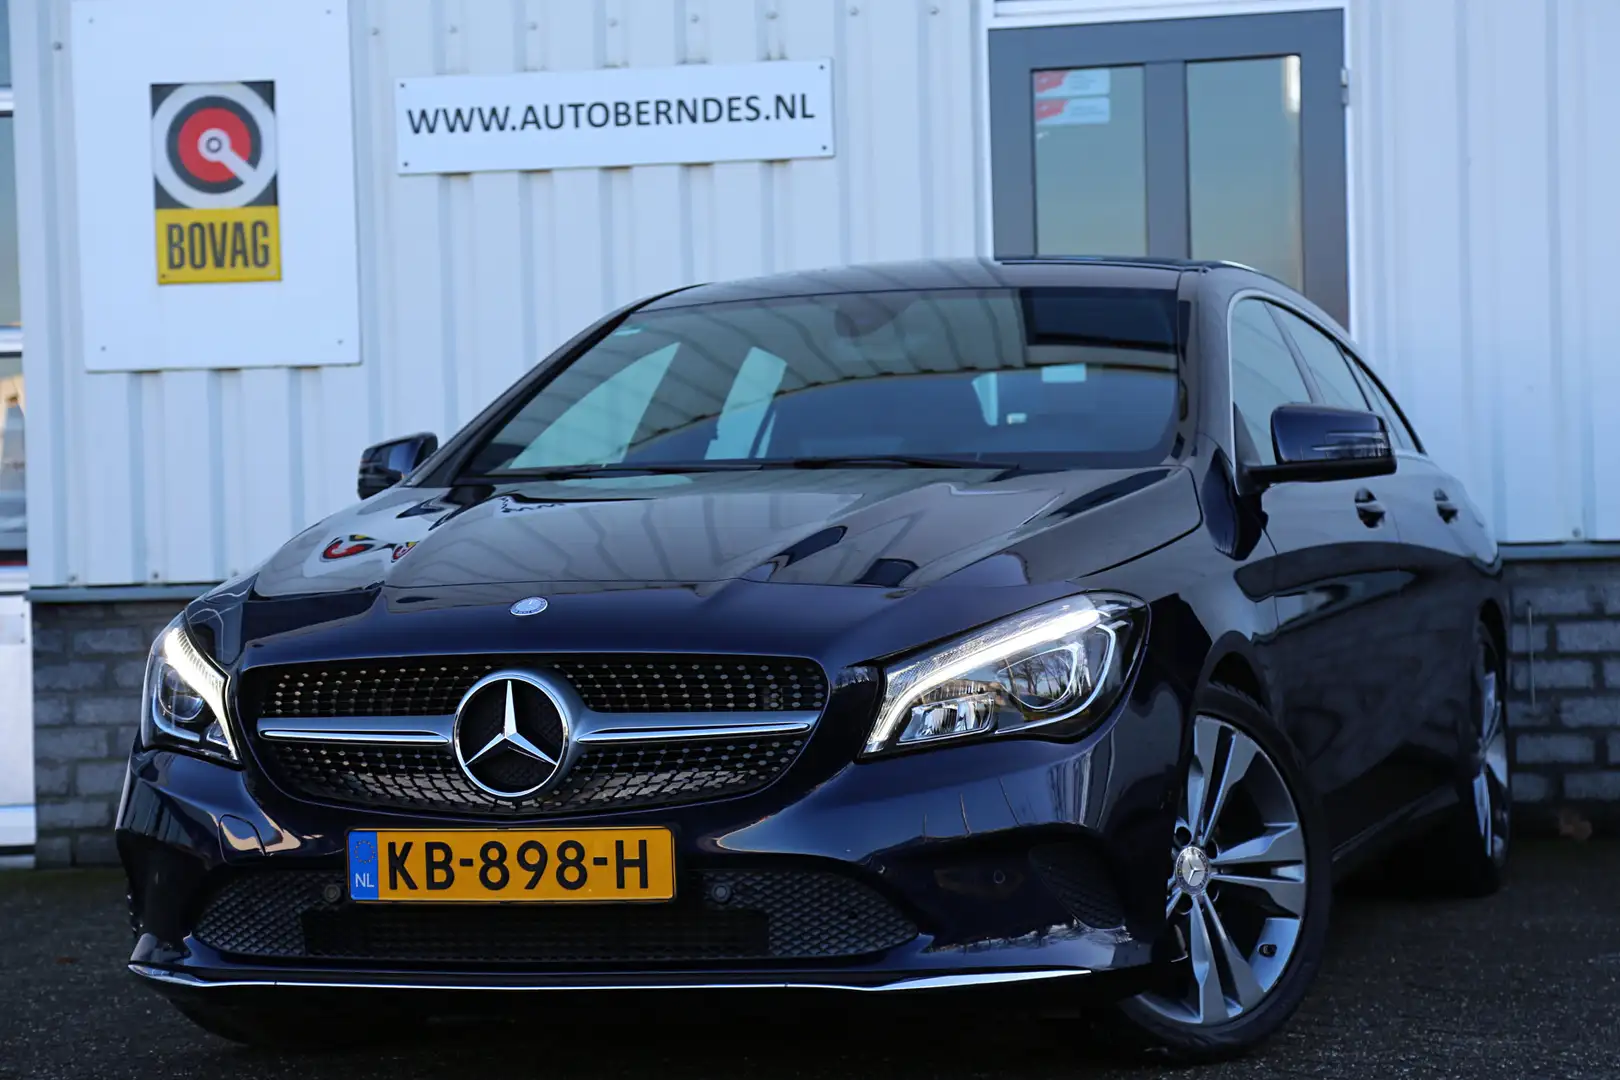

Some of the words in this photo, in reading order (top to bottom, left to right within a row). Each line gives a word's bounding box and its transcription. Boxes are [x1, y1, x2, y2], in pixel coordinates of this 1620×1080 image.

[407, 93, 815, 134] WWW.AUTOBERNDES.NL
[167, 220, 270, 270] BOVAG
[354, 872, 375, 888] NL
[387, 839, 649, 891] KB-898-H
